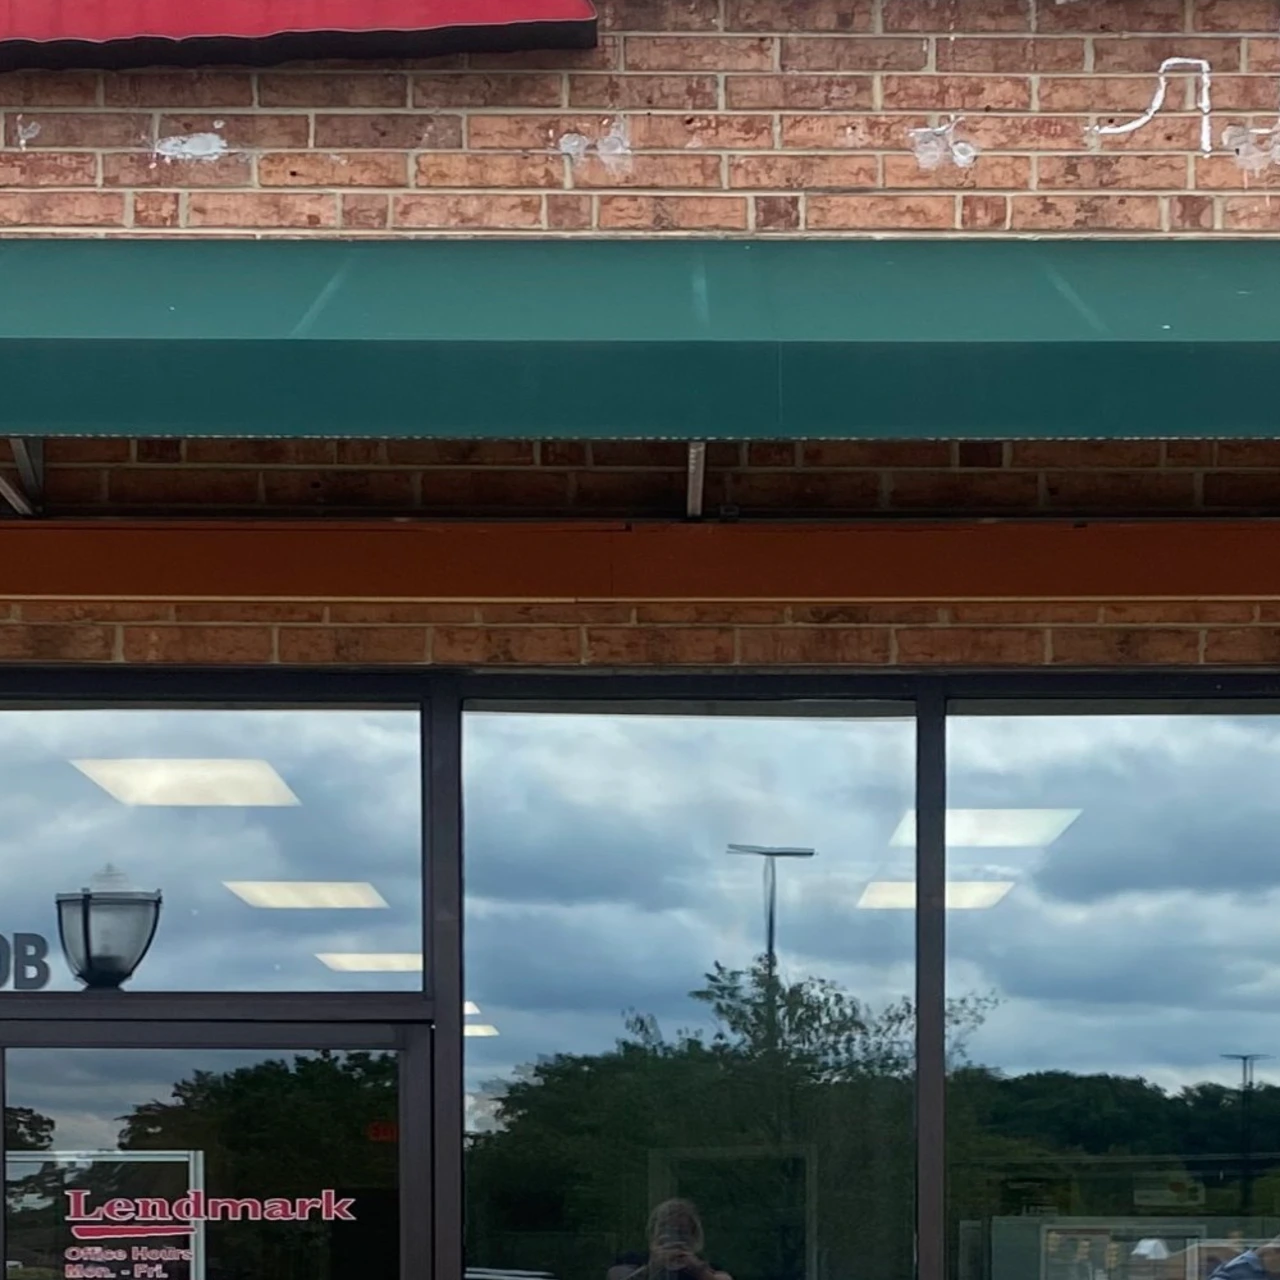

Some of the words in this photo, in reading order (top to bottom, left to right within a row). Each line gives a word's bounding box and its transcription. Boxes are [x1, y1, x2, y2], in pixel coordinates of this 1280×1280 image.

[64, 1189, 357, 1221] Lendmark
[65, 1247, 127, 1261] Office
[131, 1247, 193, 1261] Hours
[65, 1264, 116, 1278] Mon.
[133, 1264, 168, 1278] Fri.
